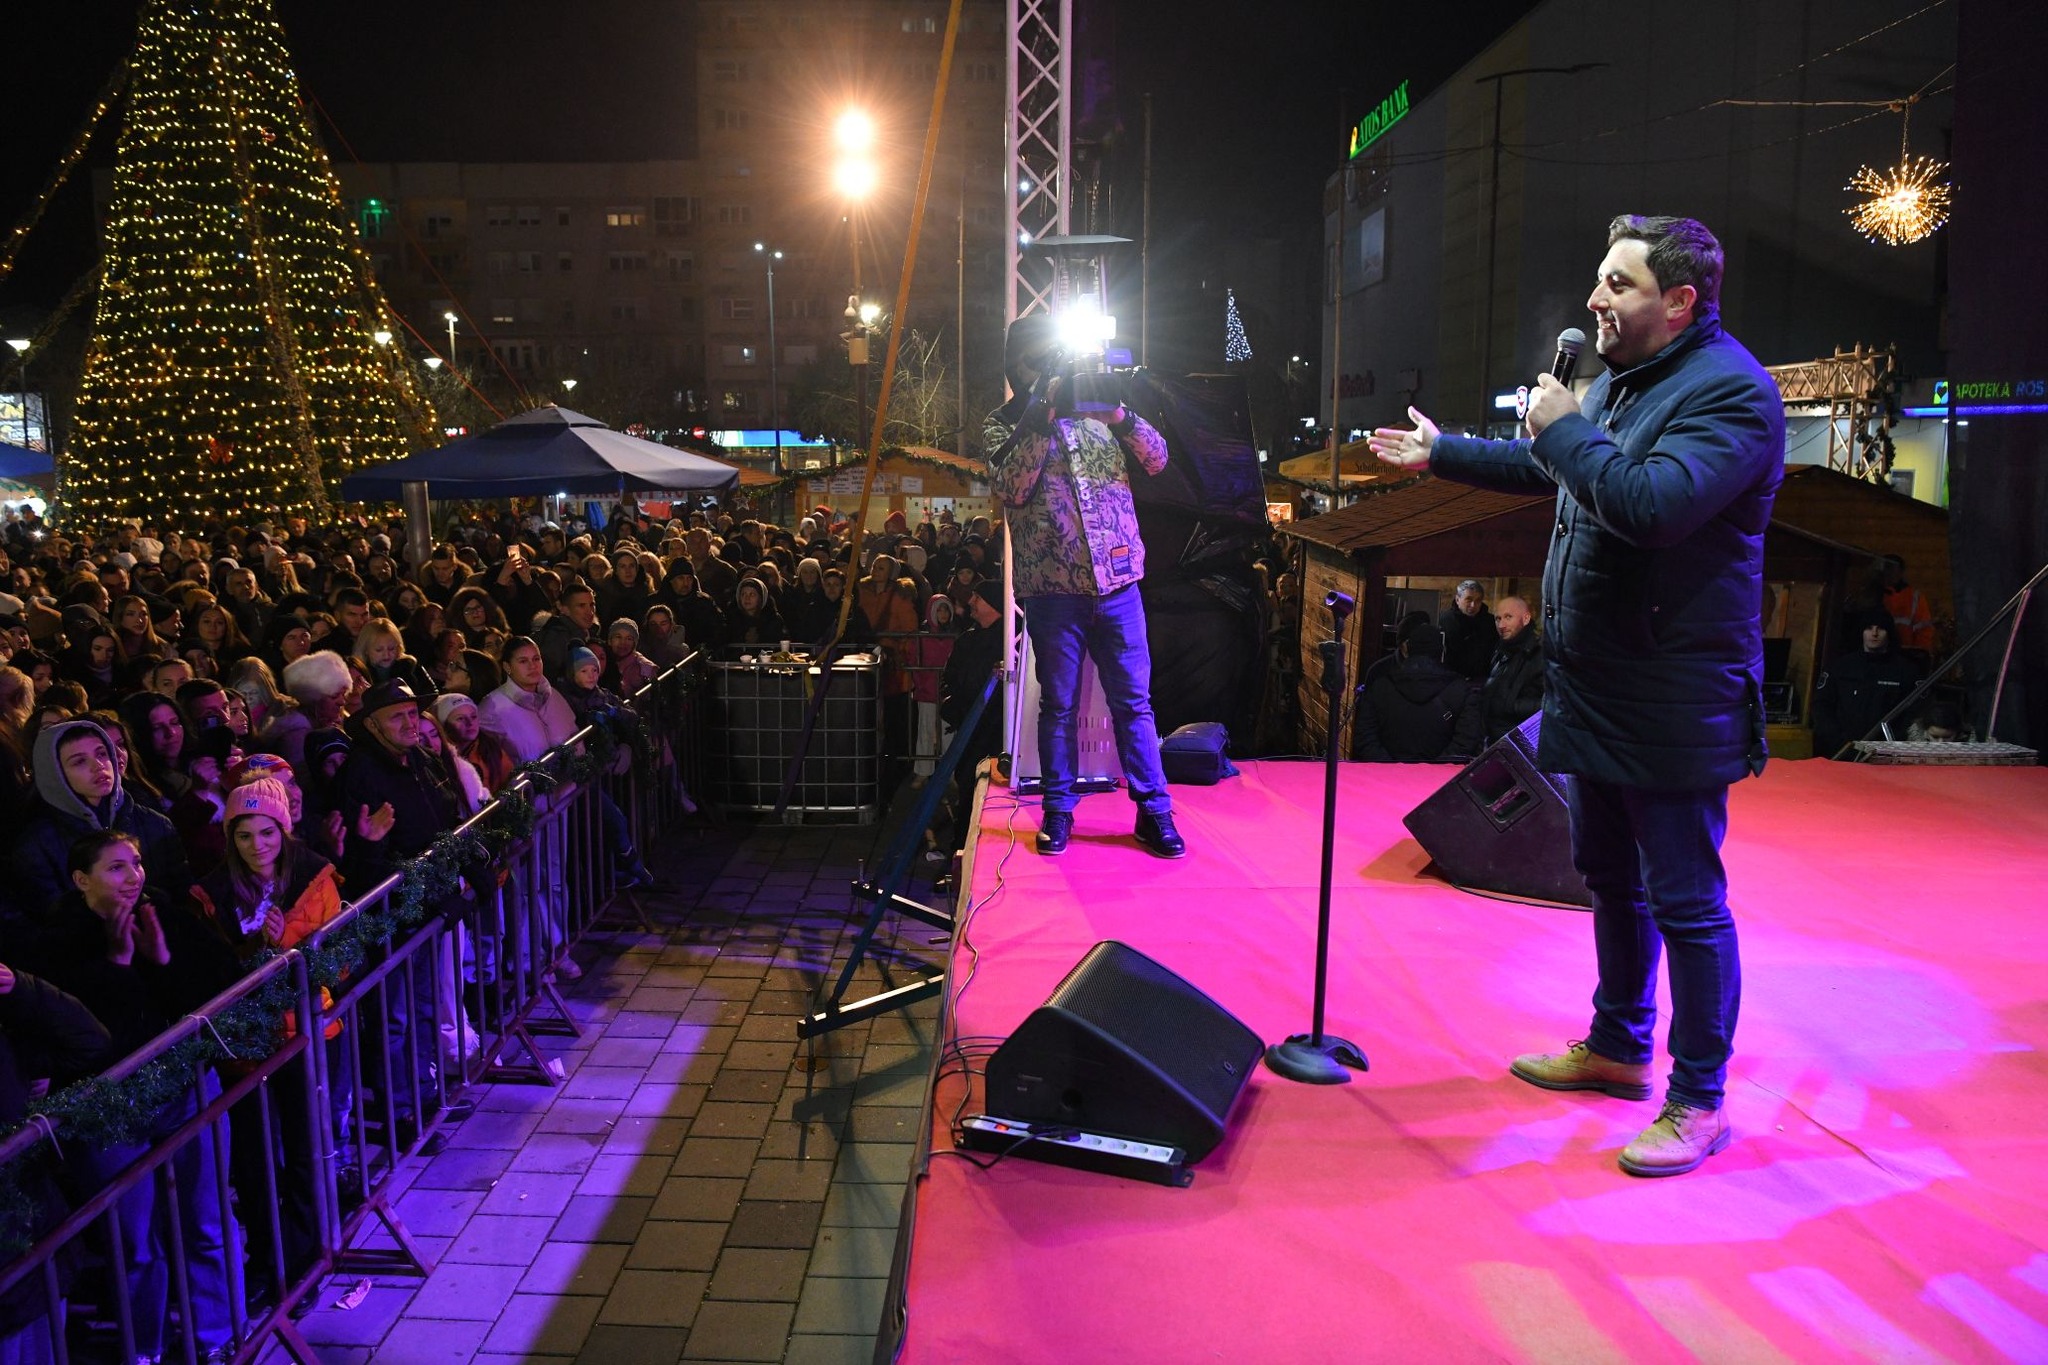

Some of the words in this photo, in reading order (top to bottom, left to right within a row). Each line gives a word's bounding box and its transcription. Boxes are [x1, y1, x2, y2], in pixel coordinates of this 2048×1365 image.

[1382, 79, 1408, 127] BANK
[1956, 382, 2010, 399] APOTEKA
[245, 799, 259, 808] M
